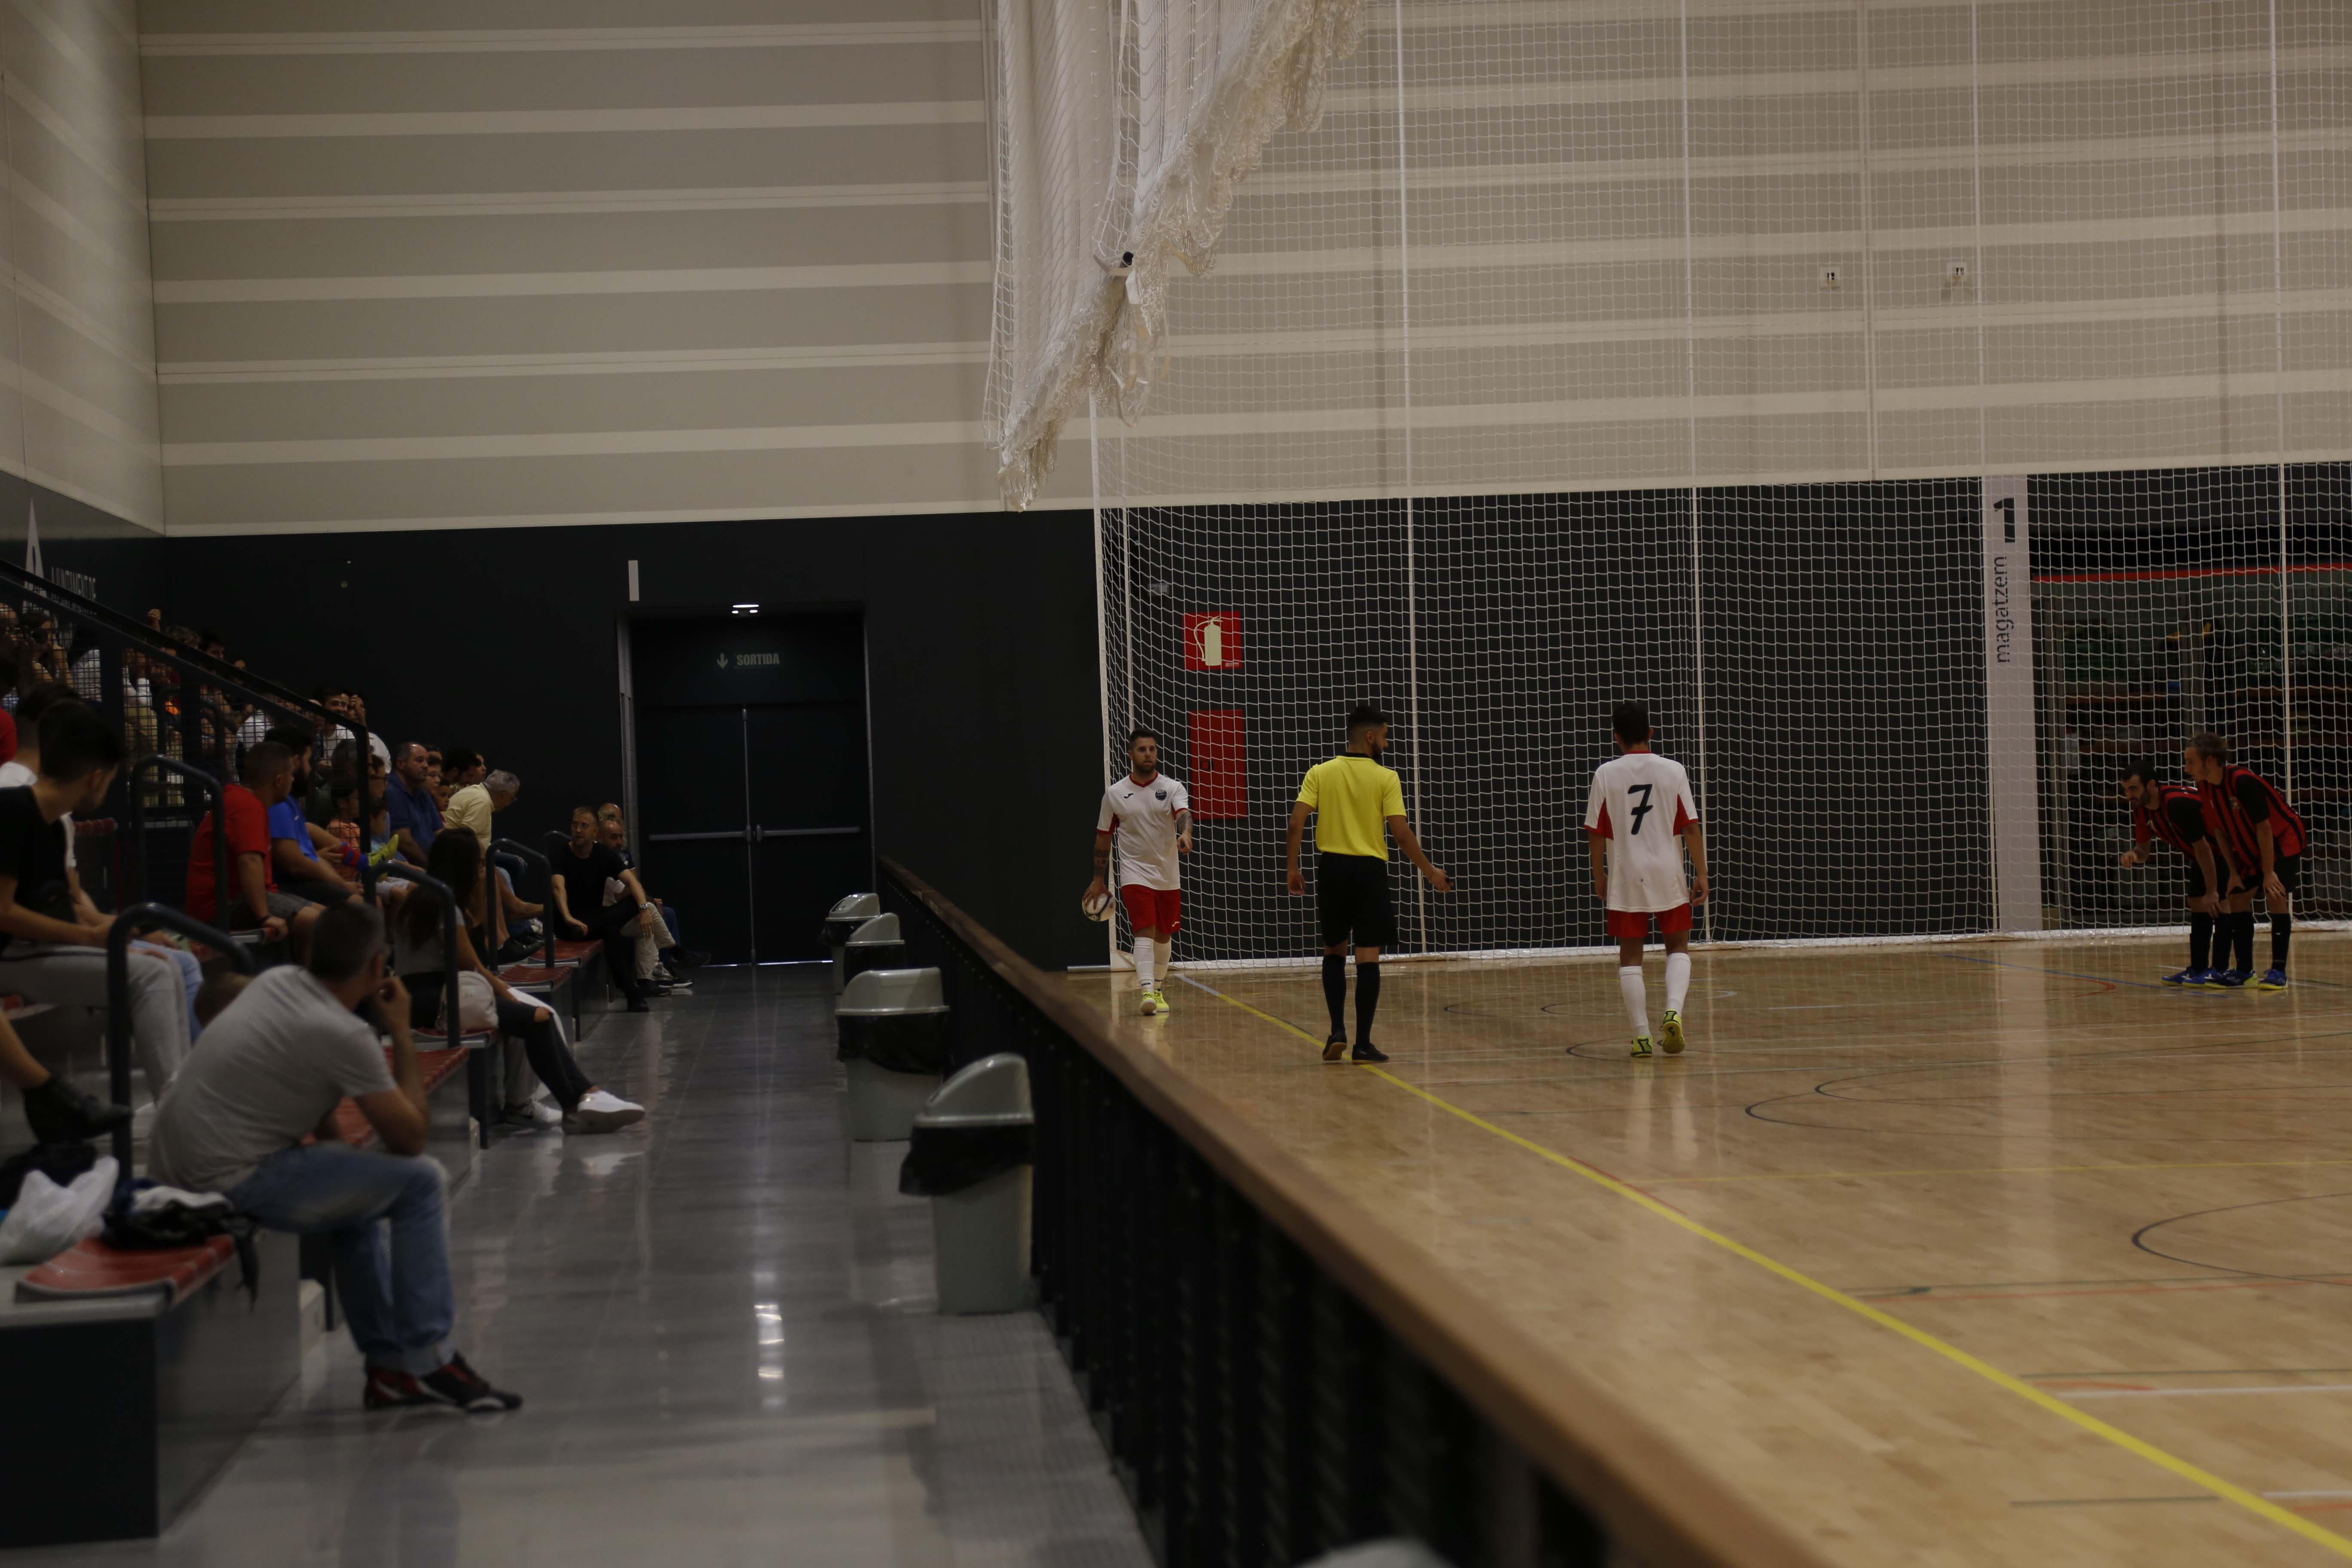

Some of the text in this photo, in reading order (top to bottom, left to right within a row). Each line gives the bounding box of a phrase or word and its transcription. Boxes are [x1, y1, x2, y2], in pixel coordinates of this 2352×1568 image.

[1994, 498, 2015, 543] 1
[1993, 556, 2014, 663] magatzem
[736, 653, 780, 666] SORTIDA
[1628, 784, 1654, 835] 7
